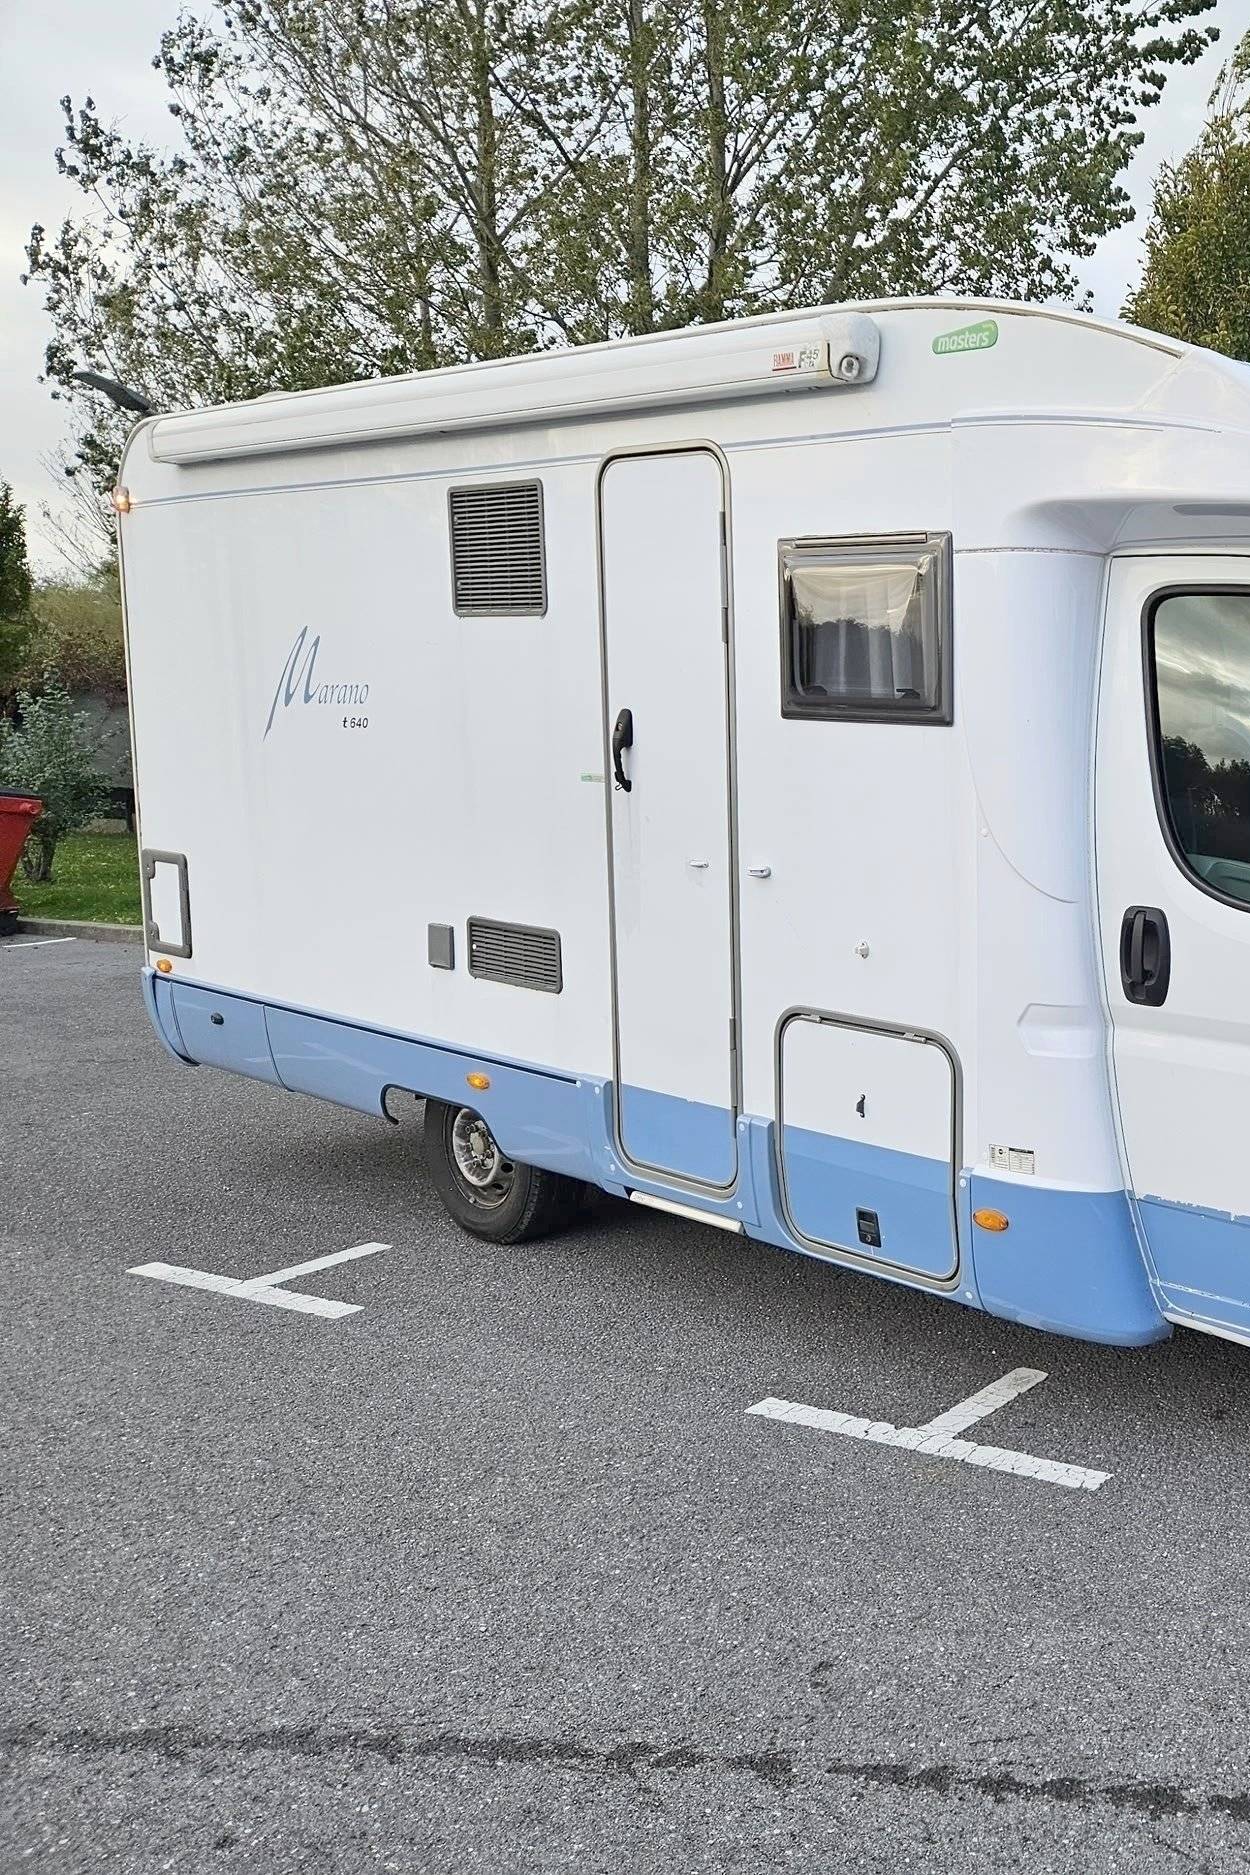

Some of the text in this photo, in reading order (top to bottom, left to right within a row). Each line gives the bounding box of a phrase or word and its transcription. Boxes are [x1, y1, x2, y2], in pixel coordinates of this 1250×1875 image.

[937, 330, 990, 352] masters
[263, 625, 369, 742] Marano
[349, 717, 369, 729] 640
